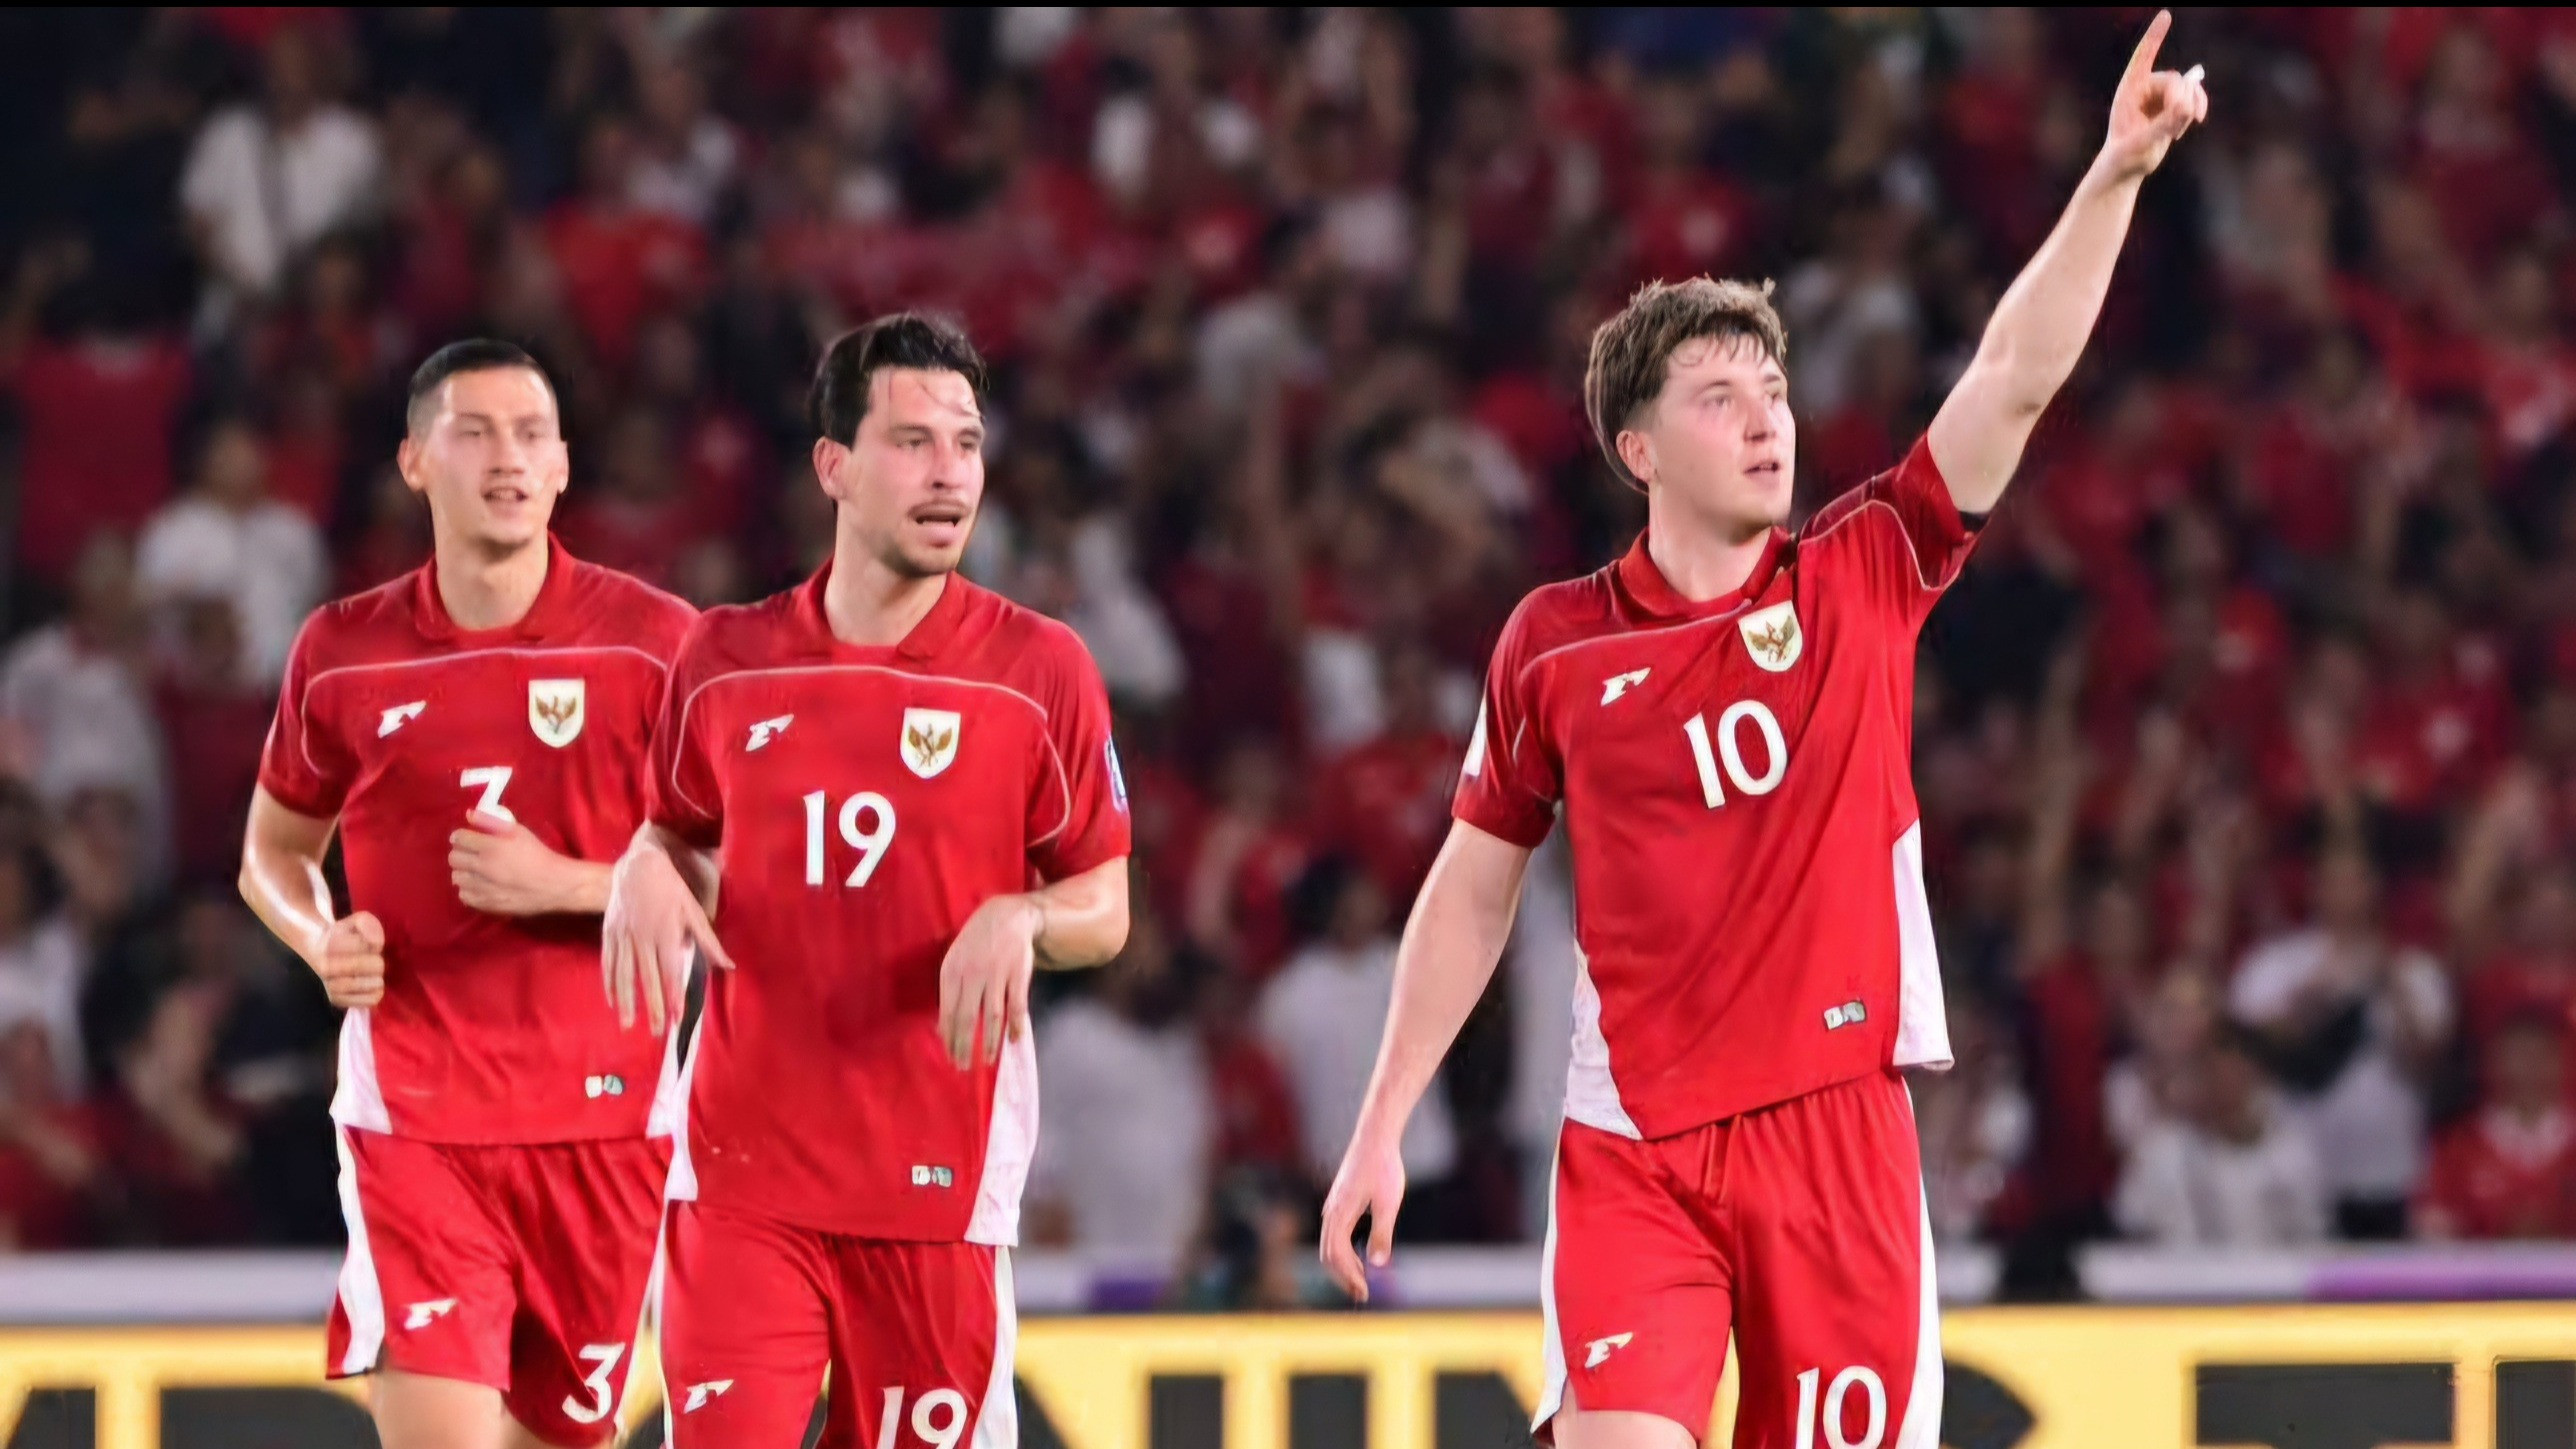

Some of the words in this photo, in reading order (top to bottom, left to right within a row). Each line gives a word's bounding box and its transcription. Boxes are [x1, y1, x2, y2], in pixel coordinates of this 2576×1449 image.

[1683, 699, 1788, 809] 10
[803, 790, 897, 888] 19
[562, 1342, 626, 1424] 3
[878, 1386, 969, 1449] 19
[1795, 1365, 1888, 1449] 10
